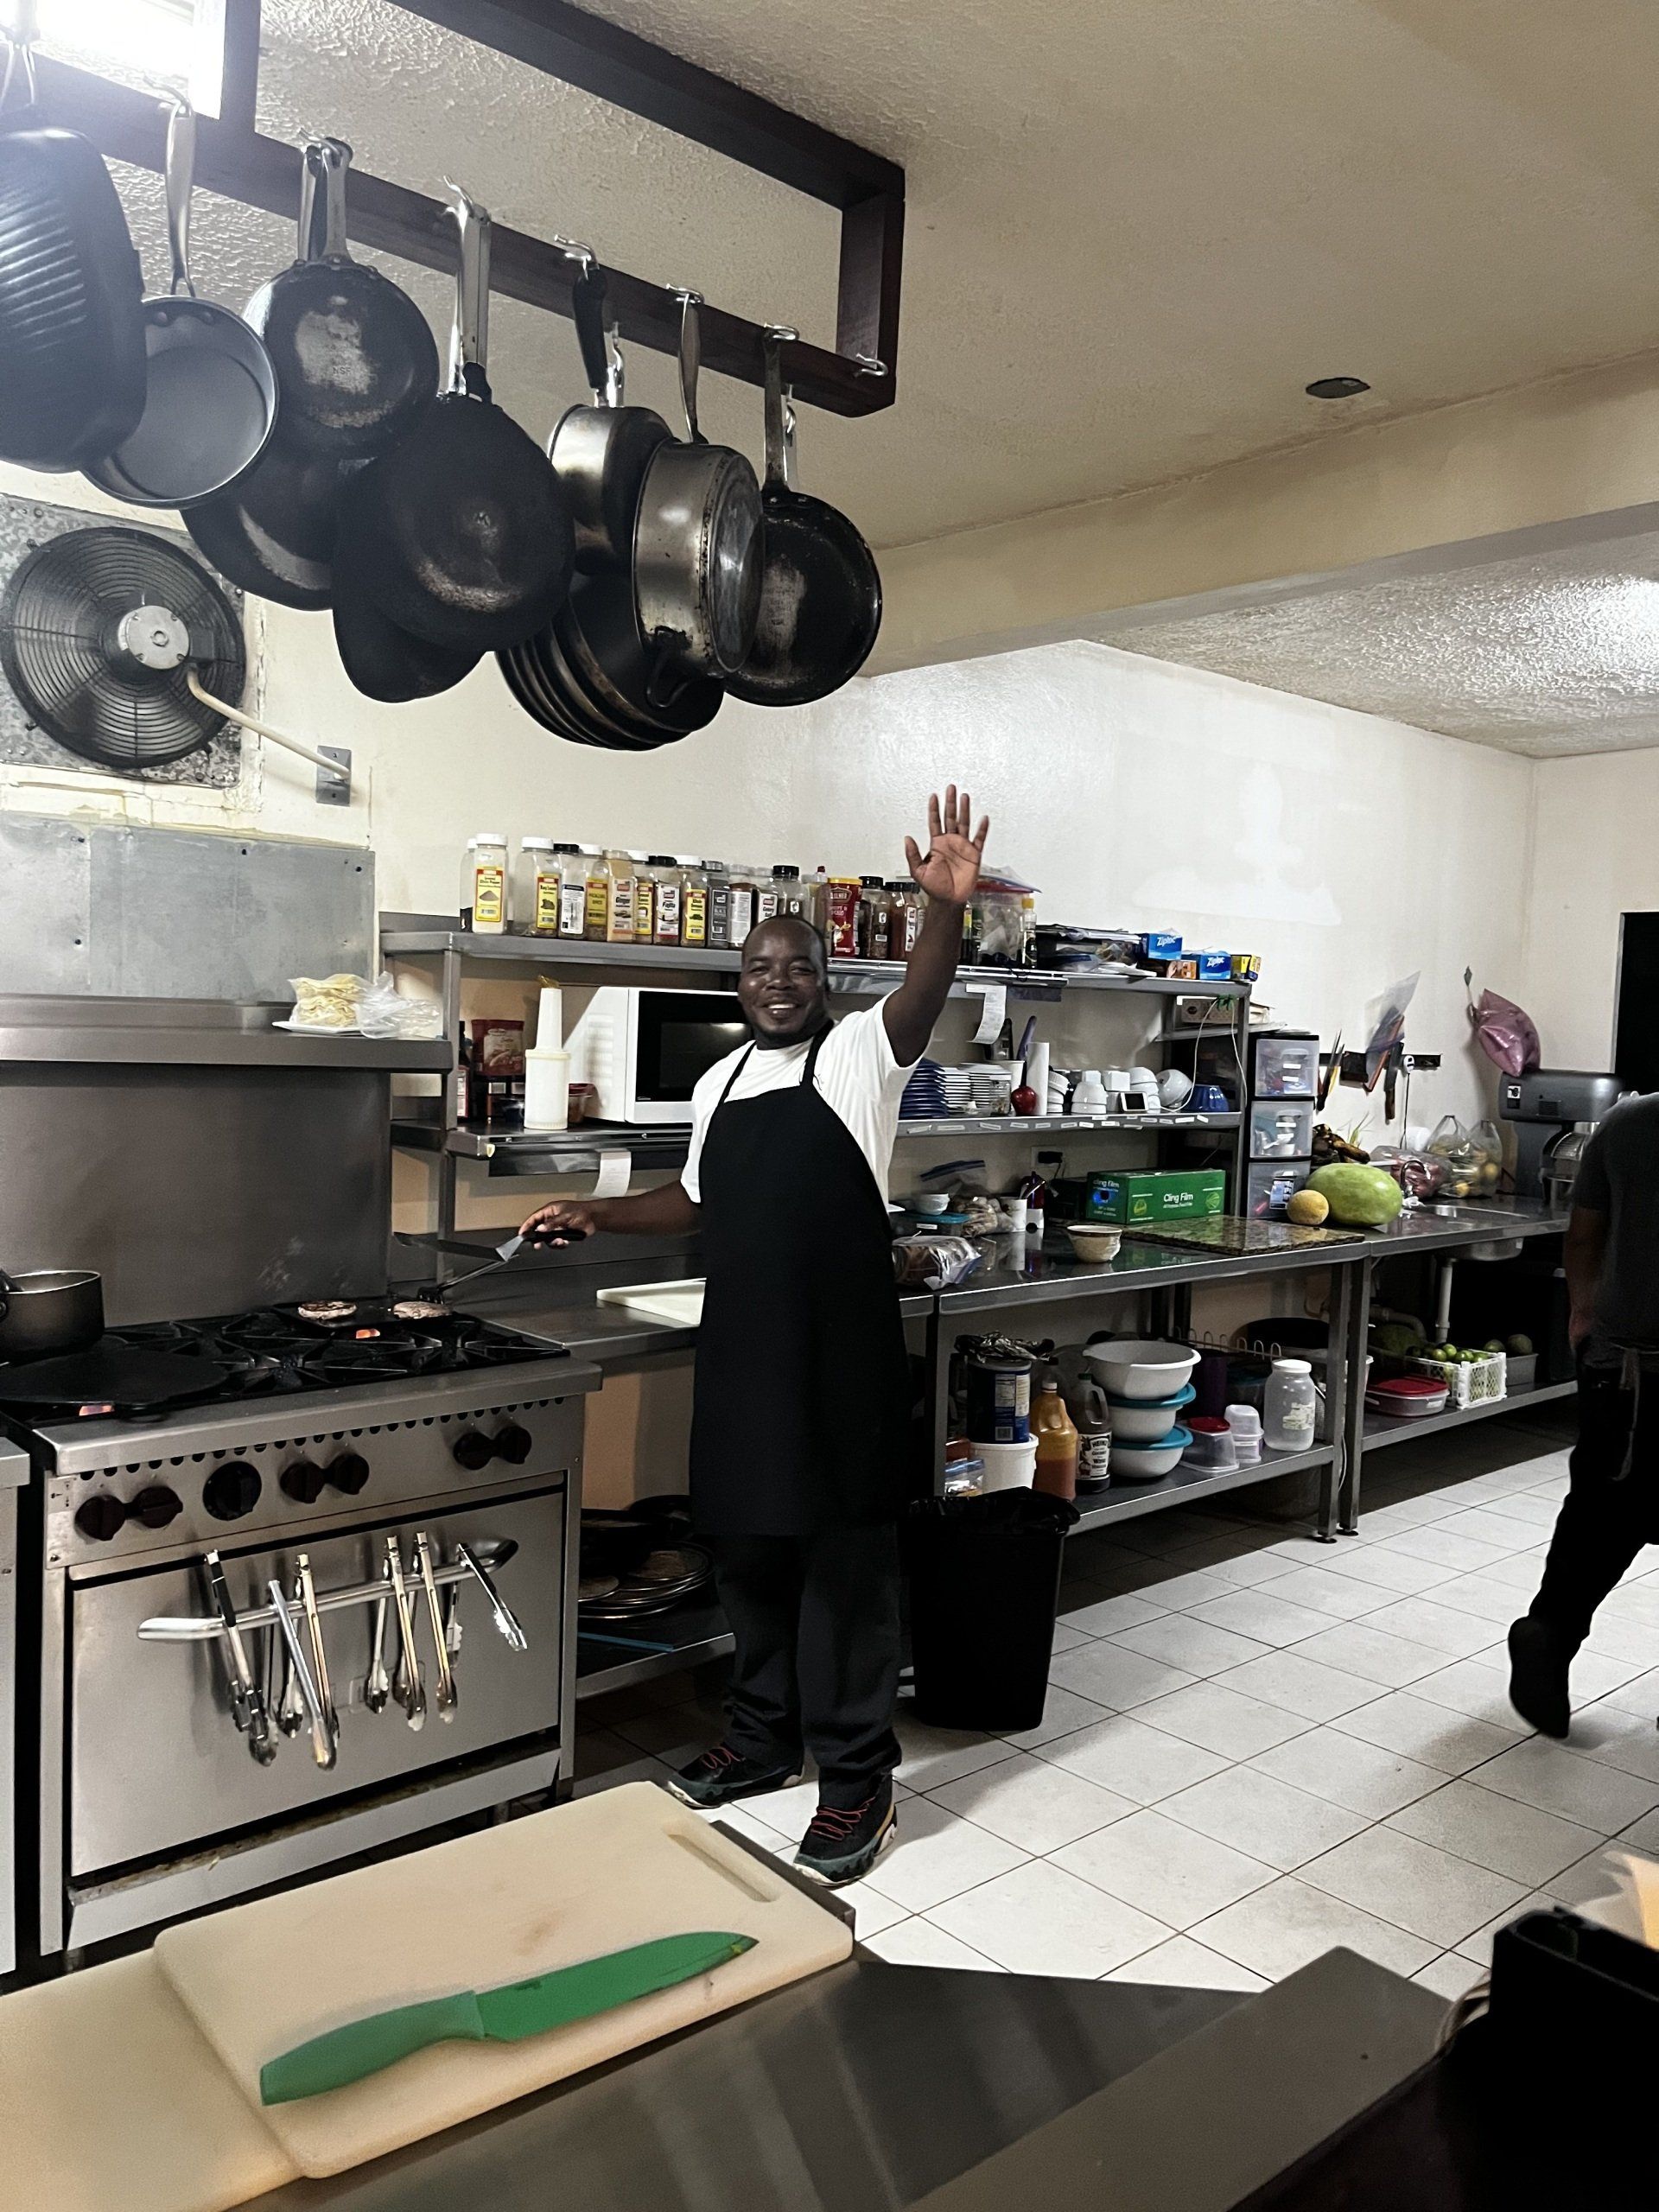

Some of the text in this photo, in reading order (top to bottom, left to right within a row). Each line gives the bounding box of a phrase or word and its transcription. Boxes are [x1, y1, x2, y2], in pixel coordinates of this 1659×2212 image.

[1157, 936, 1176, 947] Ziploc
[1206, 956, 1225, 967] Ziploc
[1163, 1192, 1193, 1204] Cling Film
